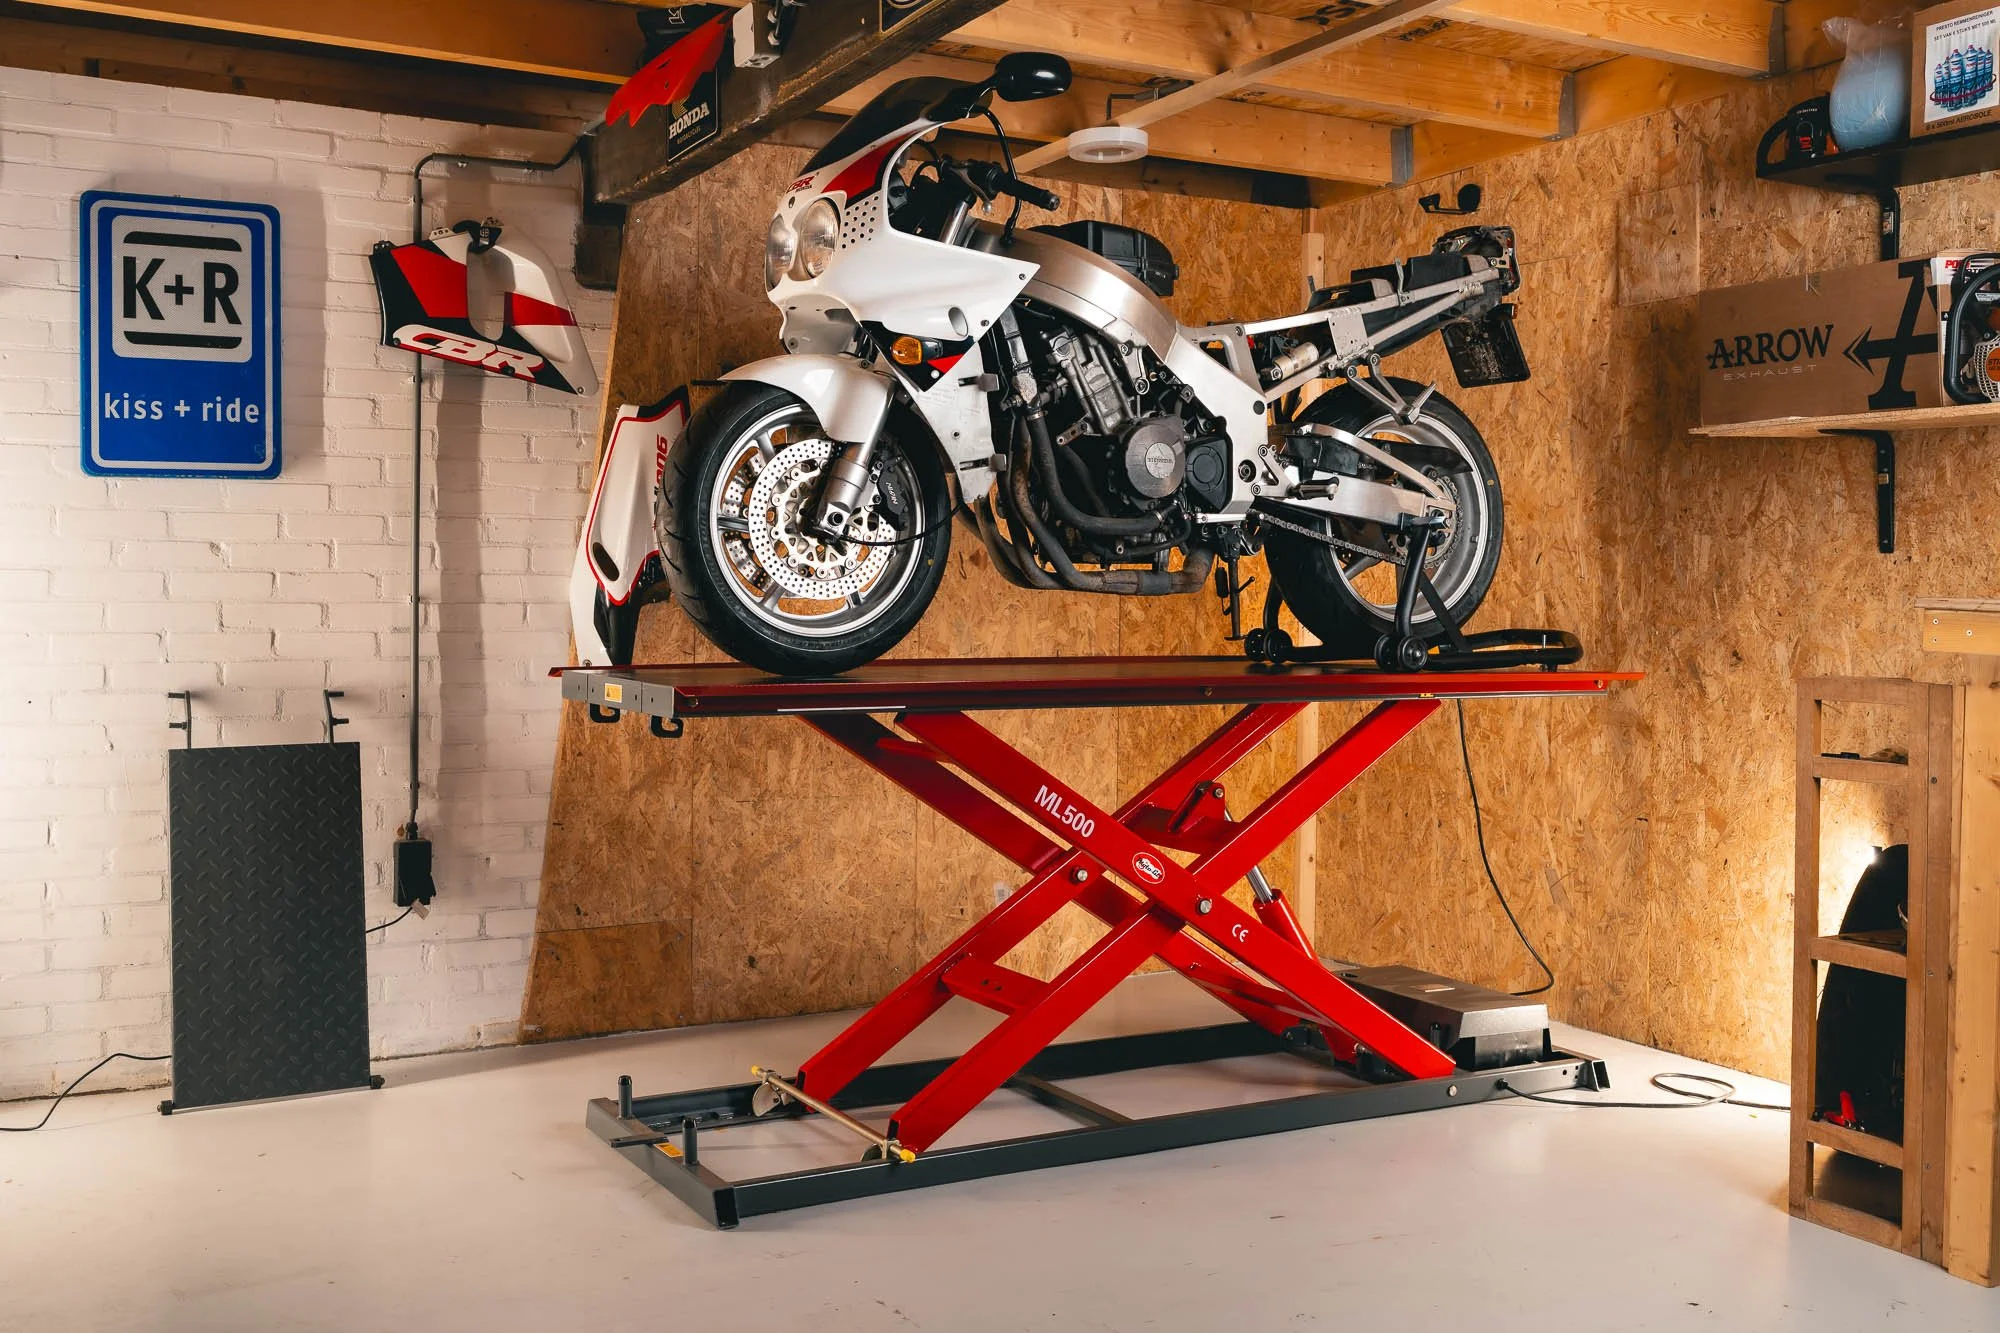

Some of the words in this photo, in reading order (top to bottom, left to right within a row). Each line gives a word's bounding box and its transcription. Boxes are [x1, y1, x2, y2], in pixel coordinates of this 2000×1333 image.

[669, 102, 710, 140] HONDA
[123, 256, 242, 325] K+R
[393, 324, 544, 383] CBR
[1706, 324, 1834, 370] ARROW
[1723, 363, 1817, 380] EXHAUST
[104, 392, 163, 420] kiss
[202, 395, 260, 423] ride
[1034, 784, 1095, 838] ML500
